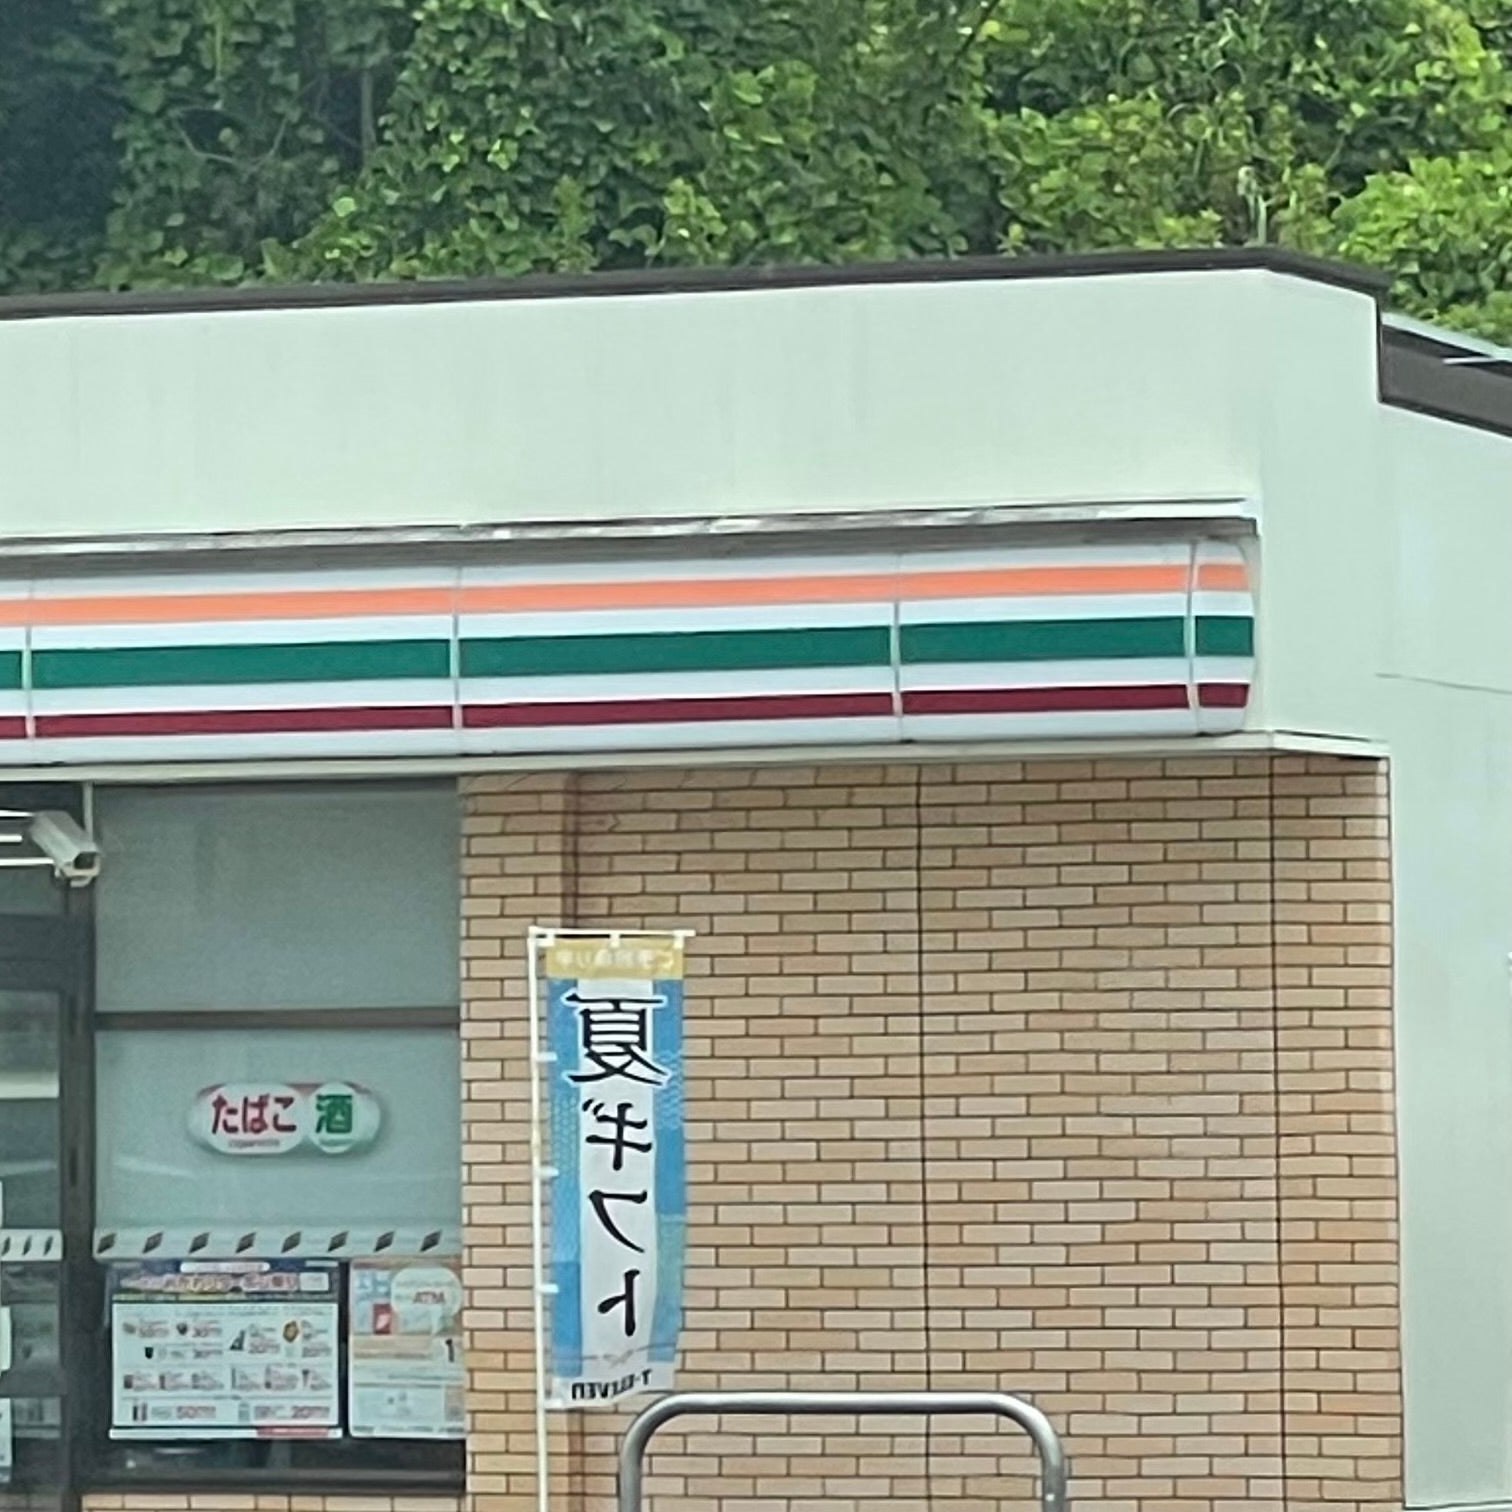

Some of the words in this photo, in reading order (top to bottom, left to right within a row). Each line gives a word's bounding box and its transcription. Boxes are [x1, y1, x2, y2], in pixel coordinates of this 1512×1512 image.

[211, 1093, 297, 1134] たばこ
[316, 1093, 353, 1134] 酒
